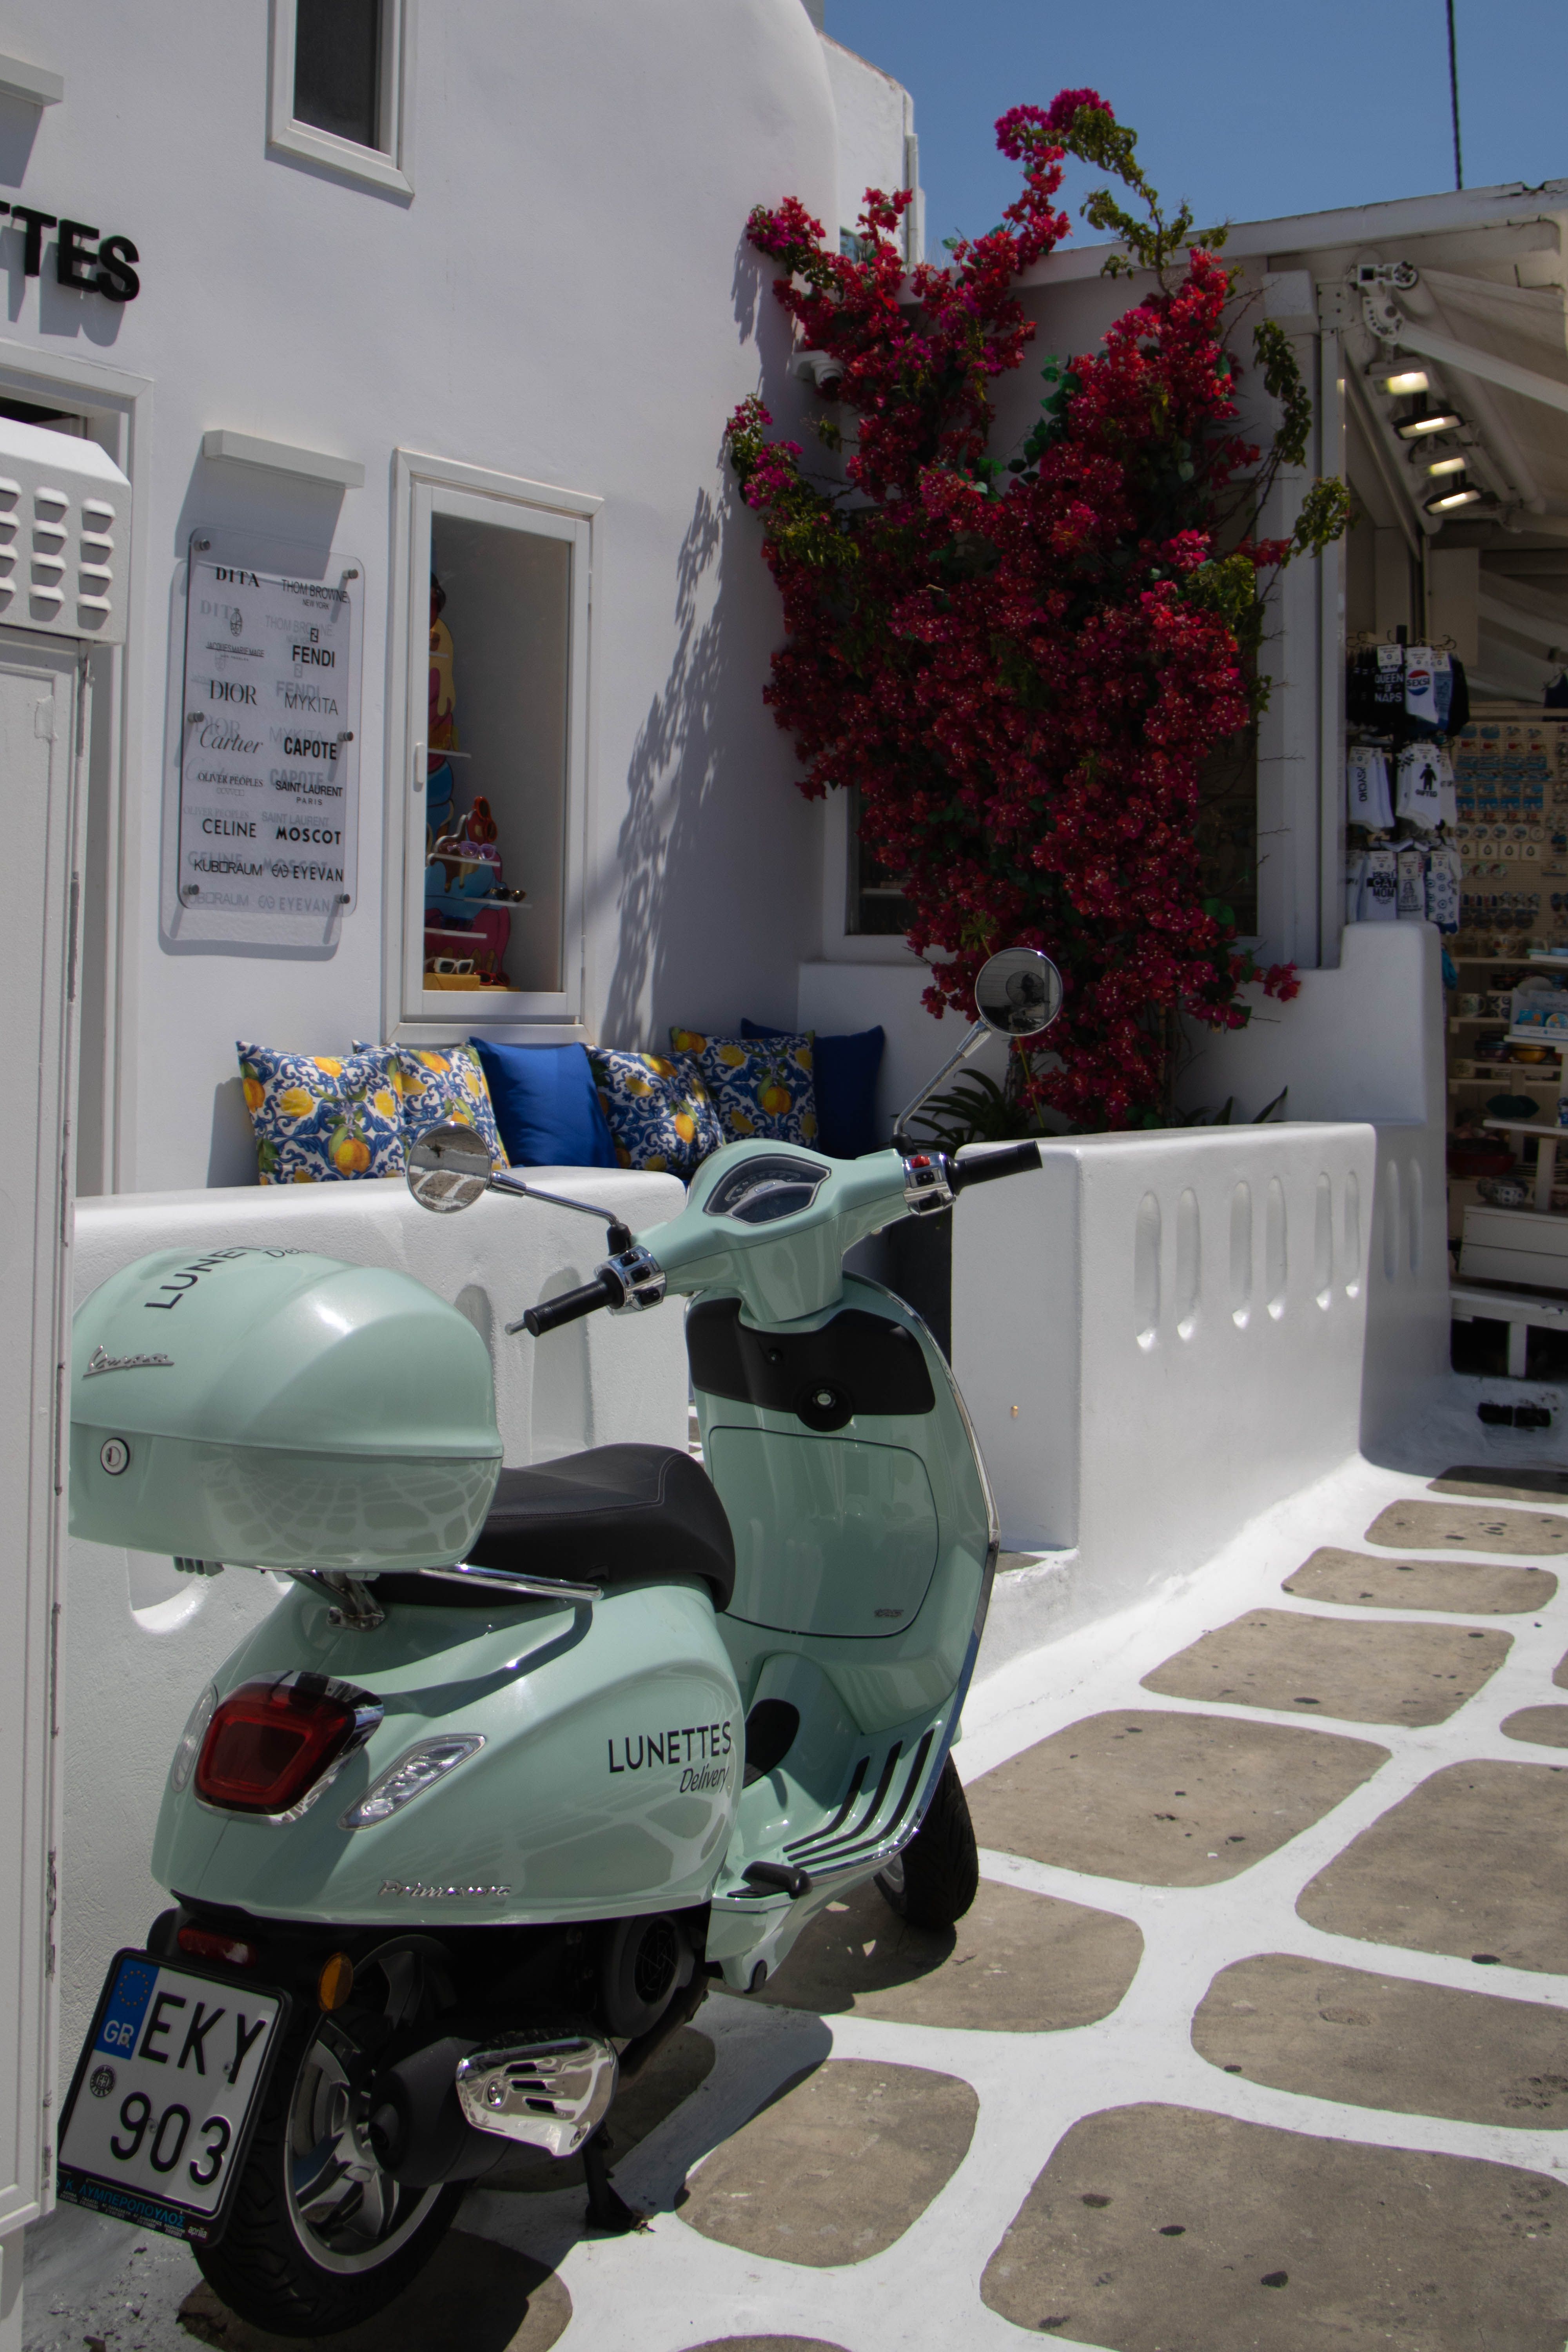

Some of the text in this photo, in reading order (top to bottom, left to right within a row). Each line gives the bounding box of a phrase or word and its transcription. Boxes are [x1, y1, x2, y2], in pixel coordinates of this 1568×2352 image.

[0, 200, 140, 302] TES
[216, 566, 260, 588] DITA
[281, 579, 309, 595] THOM
[302, 599, 330, 610] NEW YORK
[292, 645, 335, 668] FENDI
[1374, 673, 1404, 683] QUEEN
[1406, 677, 1430, 686] SEXSI
[210, 680, 258, 705] DIOR
[1374, 692, 1403, 702] NAPS
[284, 693, 339, 715] MYKITA
[200, 723, 263, 754] Cartier
[284, 737, 337, 760] CAPOTE
[198, 772, 263, 788] OLIVER PEOPLES
[276, 780, 343, 797] SAINT LAURENT
[1356, 766, 1368, 802] PSYCHO
[296, 797, 323, 806] PARIS
[202, 818, 257, 838] CELINE
[276, 826, 341, 845] MOSCOT
[293, 866, 343, 882] EYEVAN
[1373, 878, 1394, 887] CAT
[1373, 887, 1394, 897] MOM
[608, 1720, 731, 1773] LUNETTES
[679, 1763, 730, 1793] Delivery
[377, 1879, 511, 1897] Primavera
[103, 2019, 134, 2048] GR
[138, 1991, 267, 2085] EKY
[110, 2091, 232, 2186] 903
[188, 2226, 207, 2239] aprilia
